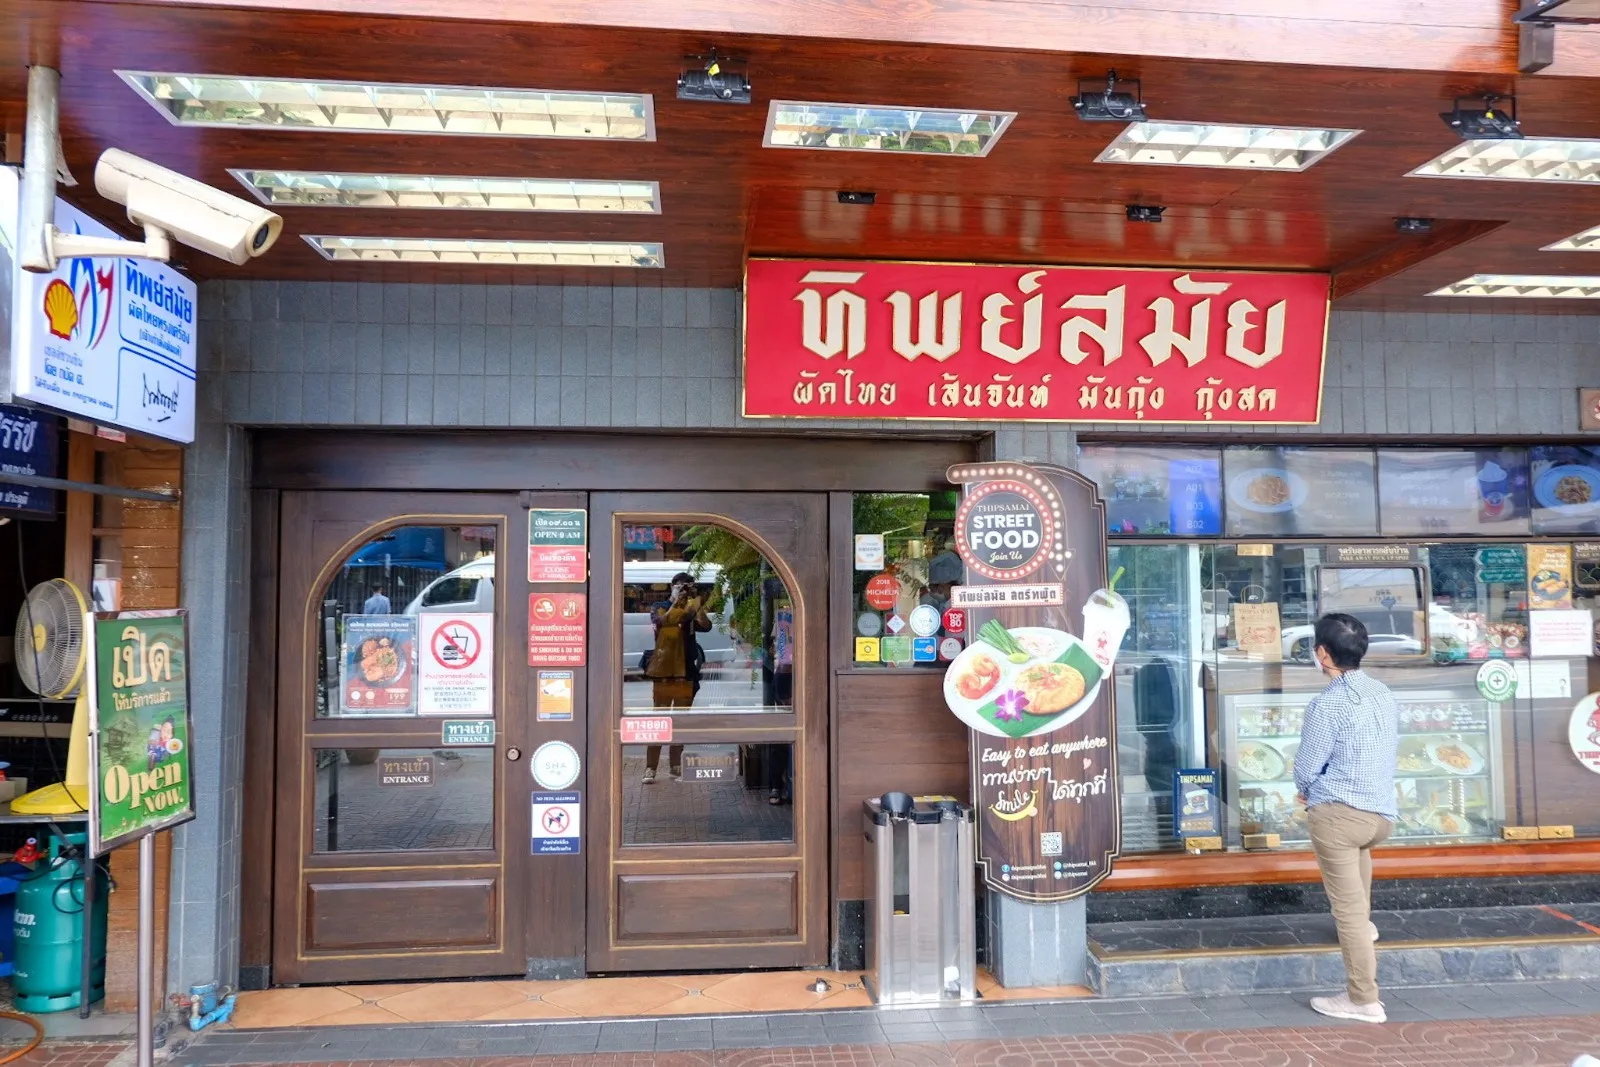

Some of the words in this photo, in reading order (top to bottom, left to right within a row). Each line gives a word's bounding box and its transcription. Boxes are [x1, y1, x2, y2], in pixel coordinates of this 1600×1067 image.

[793, 270, 1287, 368] ทิพย์สมัย
[793, 369, 896, 406] ผัดไทย
[1078, 375, 1164, 419] มันกุ้ง
[1196, 376, 1277, 420] กุ้งสด
[976, 504, 1030, 512] THIPSAMAI
[973, 513, 1034, 529] STREET
[534, 531, 557, 539] OPEN
[566, 531, 581, 539] AM
[970, 529, 1039, 550] FOOD
[988, 551, 1008, 563] Join
[1009, 550, 1023, 560] Us
[112, 625, 170, 689] เปิด
[112, 687, 171, 711] ให้บริการแล้ว
[448, 721, 489, 735] ทางเข้า
[626, 719, 668, 730] ทางออก
[635, 732, 659, 740] EXIT
[982, 748, 1011, 767] Easy
[1015, 746, 1026, 758] to
[1029, 742, 1049, 757] eat
[1051, 735, 1107, 759] anywhere
[384, 758, 429, 773] ทางเข้า
[696, 769, 722, 778] EXIT
[104, 762, 182, 810] Open
[383, 776, 430, 784] ENTRANCE
[982, 765, 1052, 786] ทานง่ายๆ
[1051, 768, 1107, 804] ได้ทุกที่
[995, 789, 1030, 811] Smile
